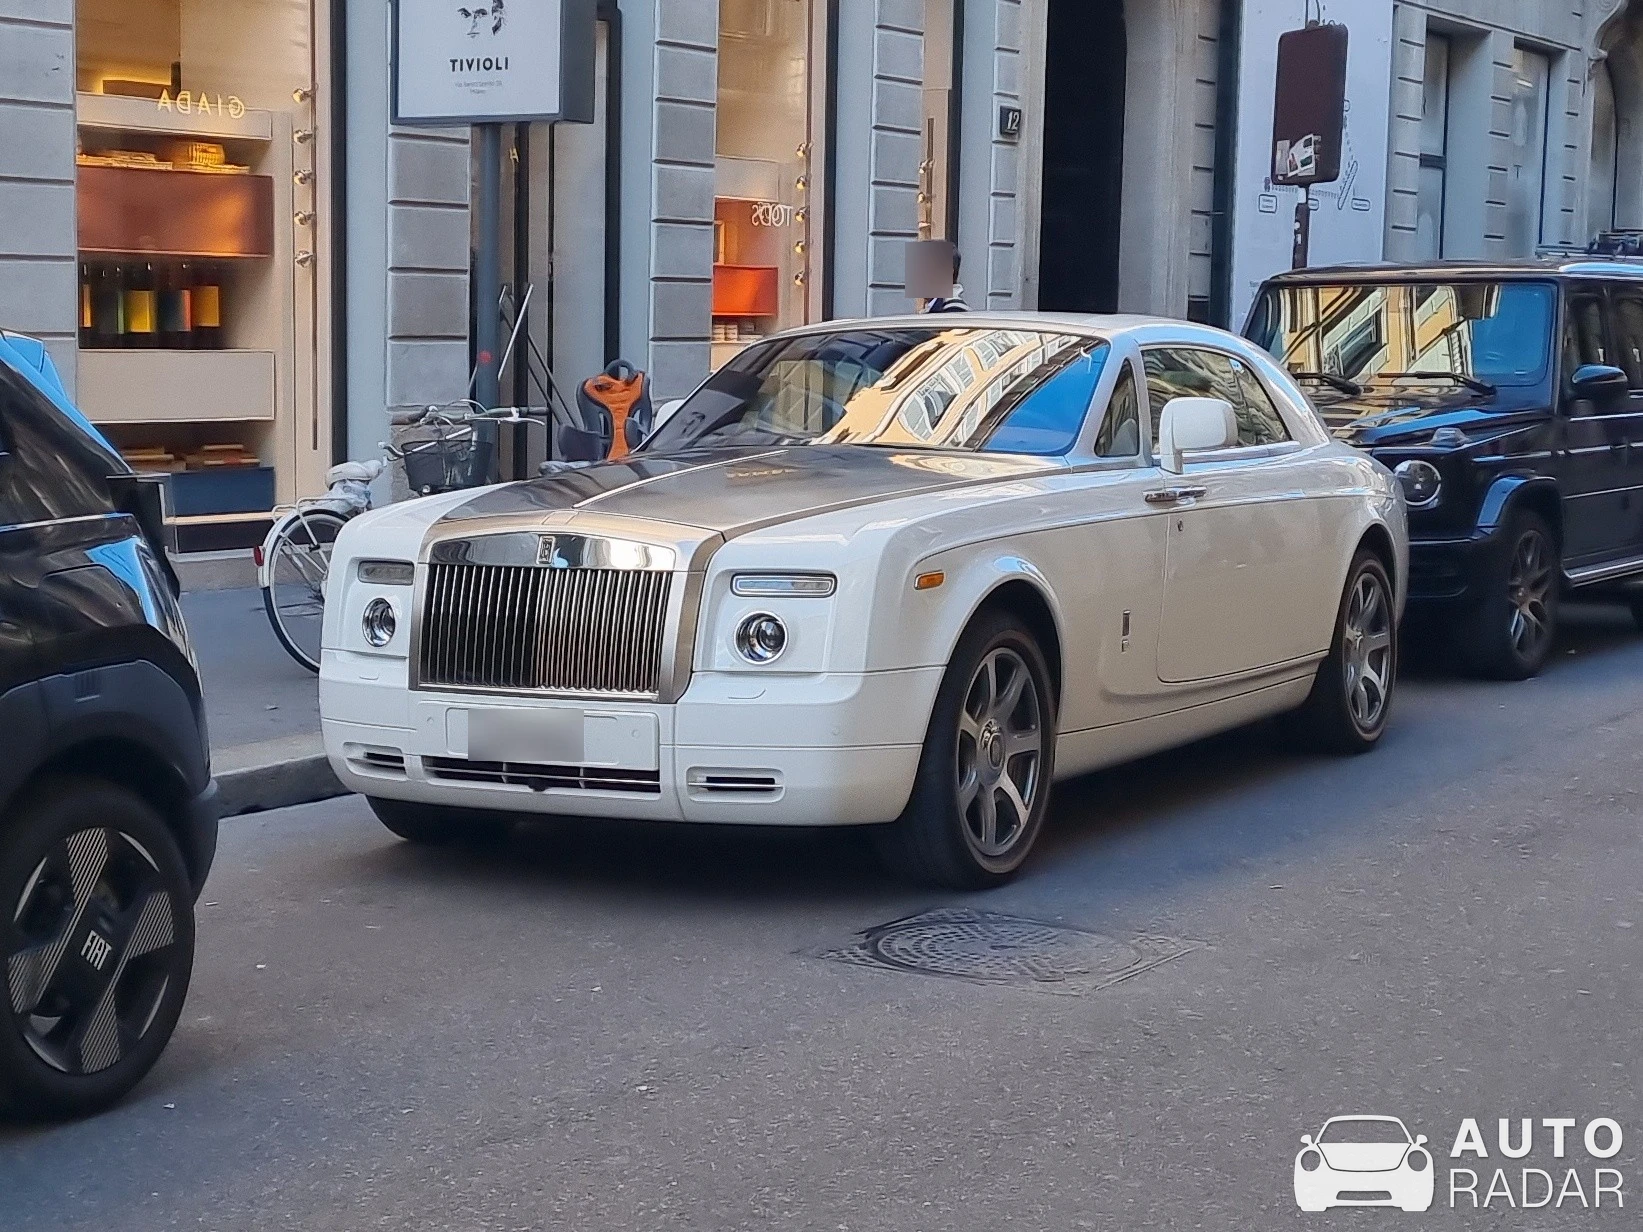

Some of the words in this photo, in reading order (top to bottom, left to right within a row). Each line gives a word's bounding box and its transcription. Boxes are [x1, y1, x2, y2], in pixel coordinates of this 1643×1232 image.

[450, 57, 509, 72] TIVIOLI
[1007, 110, 1020, 131] 12
[81, 930, 112, 971] FIAT
